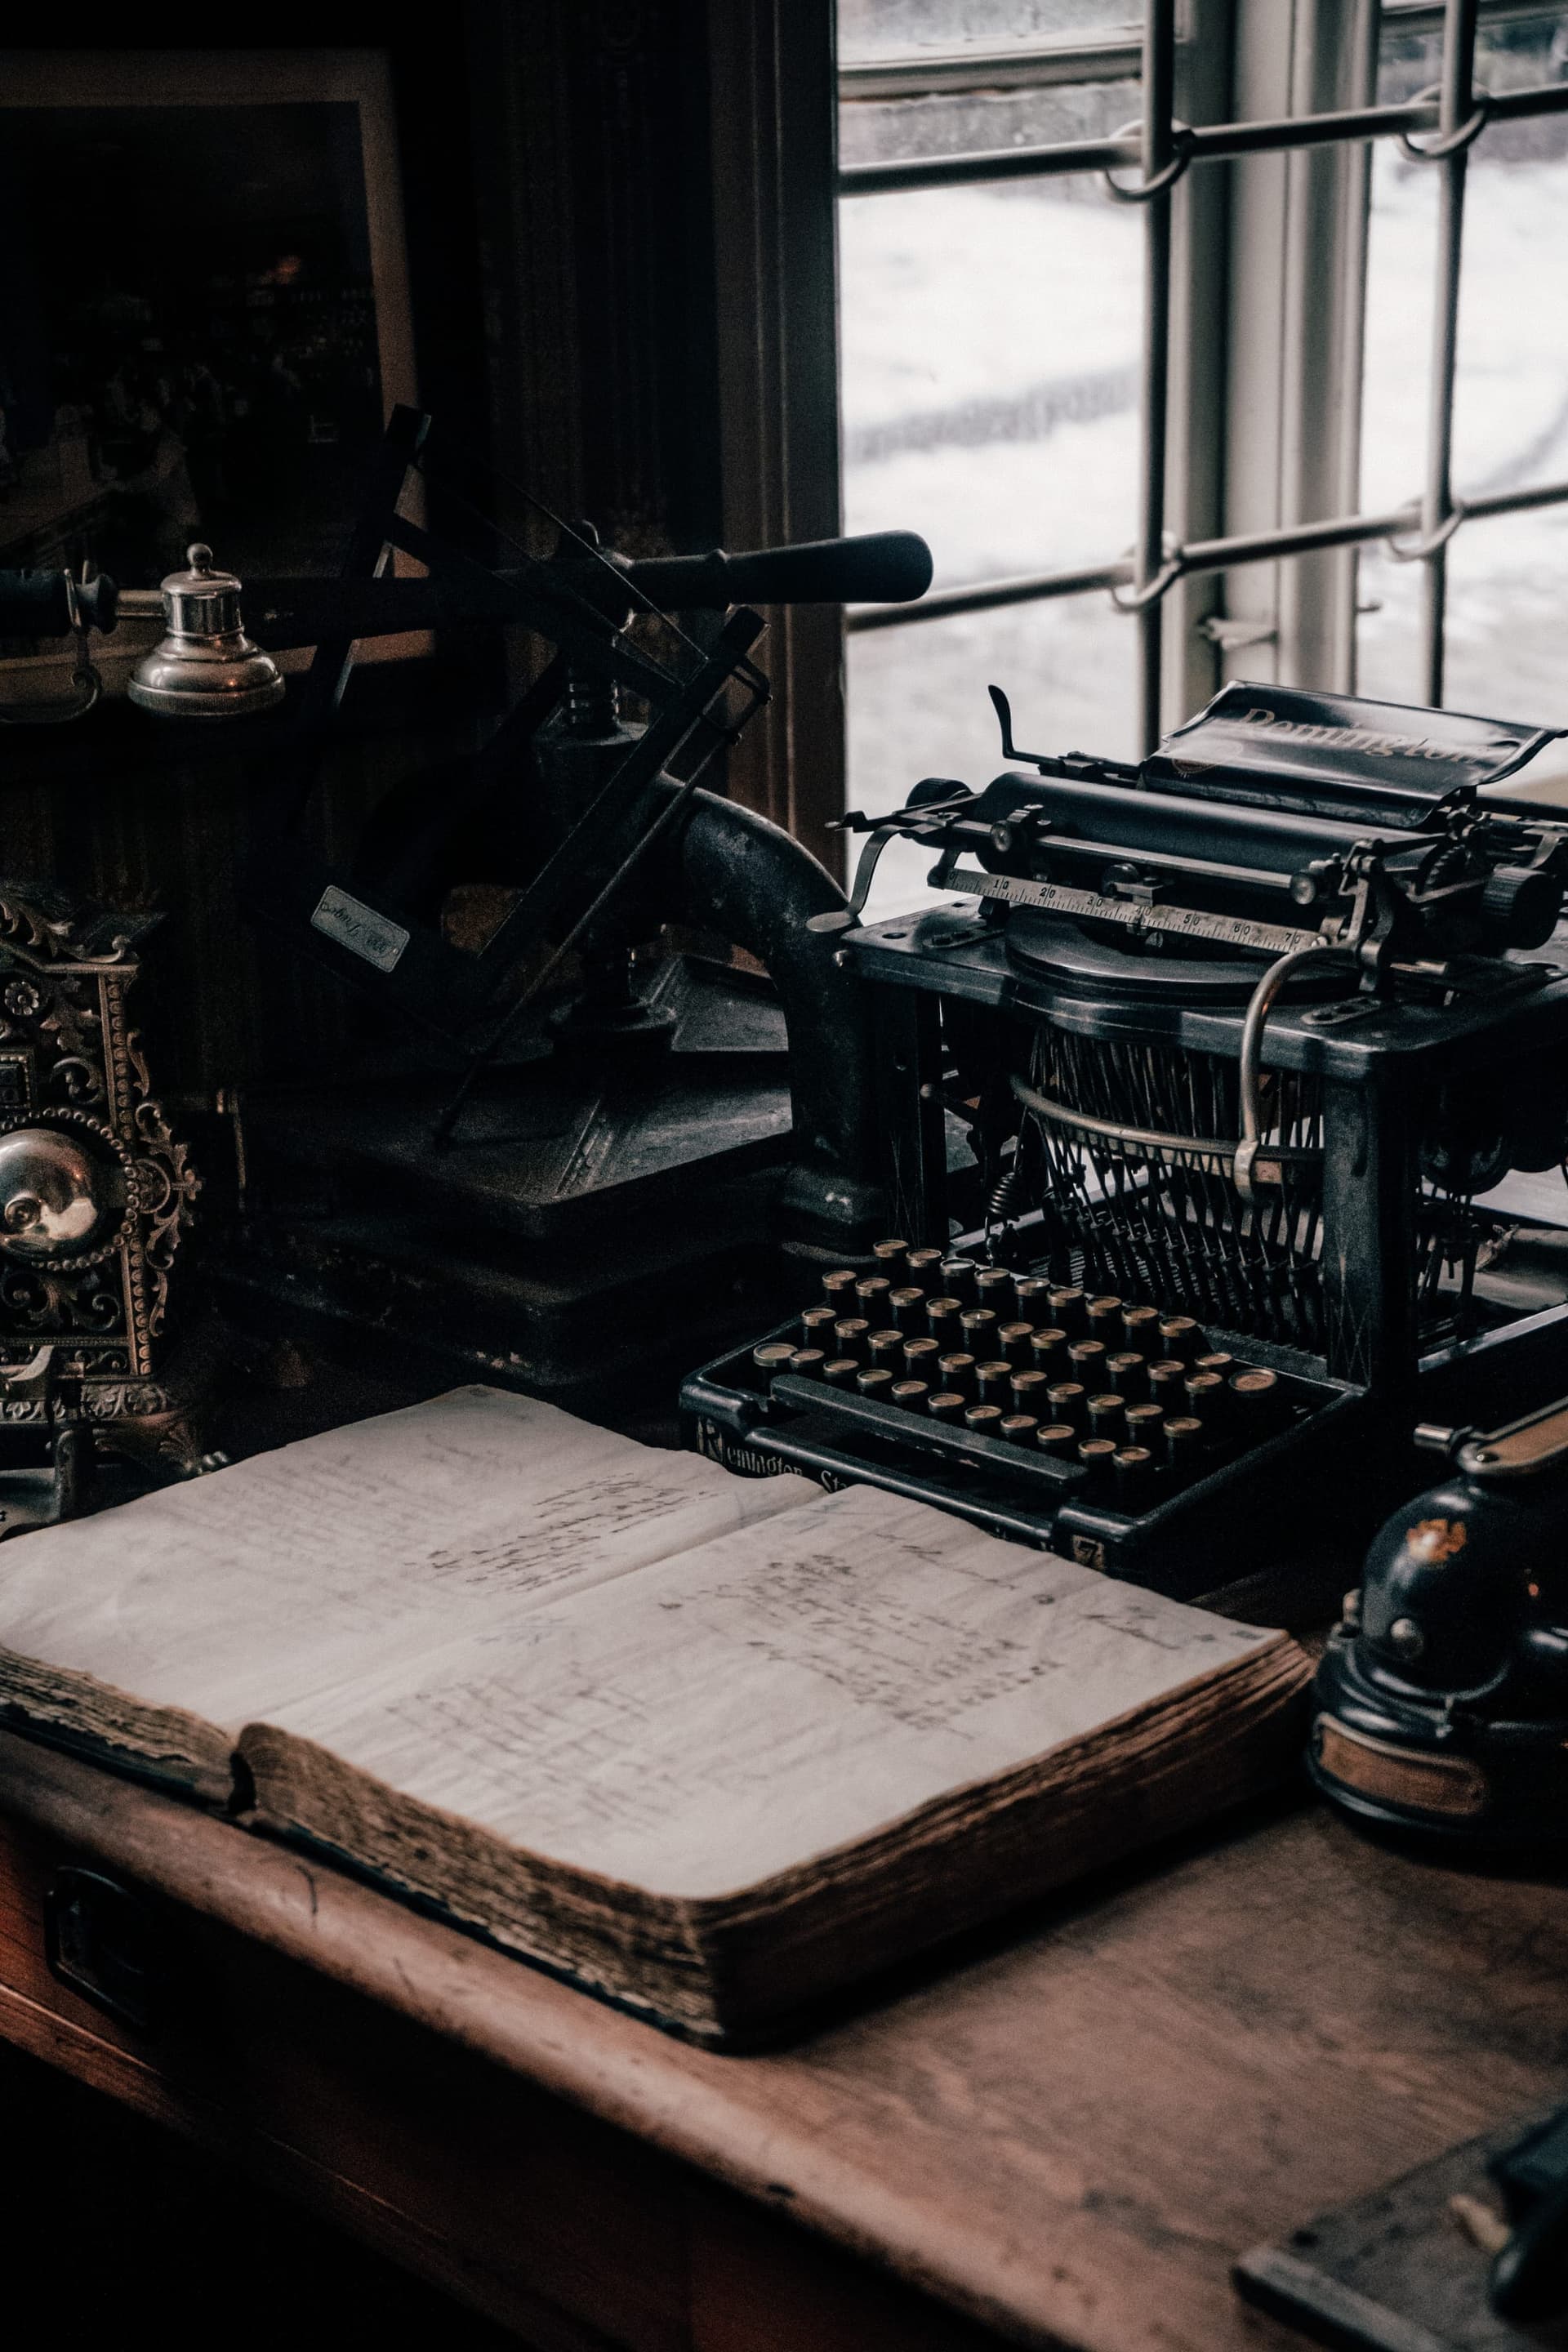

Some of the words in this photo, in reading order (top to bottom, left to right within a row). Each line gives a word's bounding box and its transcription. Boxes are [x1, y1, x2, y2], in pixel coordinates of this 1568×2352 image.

[993, 879, 1009, 889] 10
[1039, 887, 1056, 898] 20
[1087, 896, 1103, 907] 30
[1135, 906, 1152, 916] 40
[1183, 914, 1200, 926] 50
[1234, 923, 1250, 935] 60
[1285, 933, 1300, 944] 70
